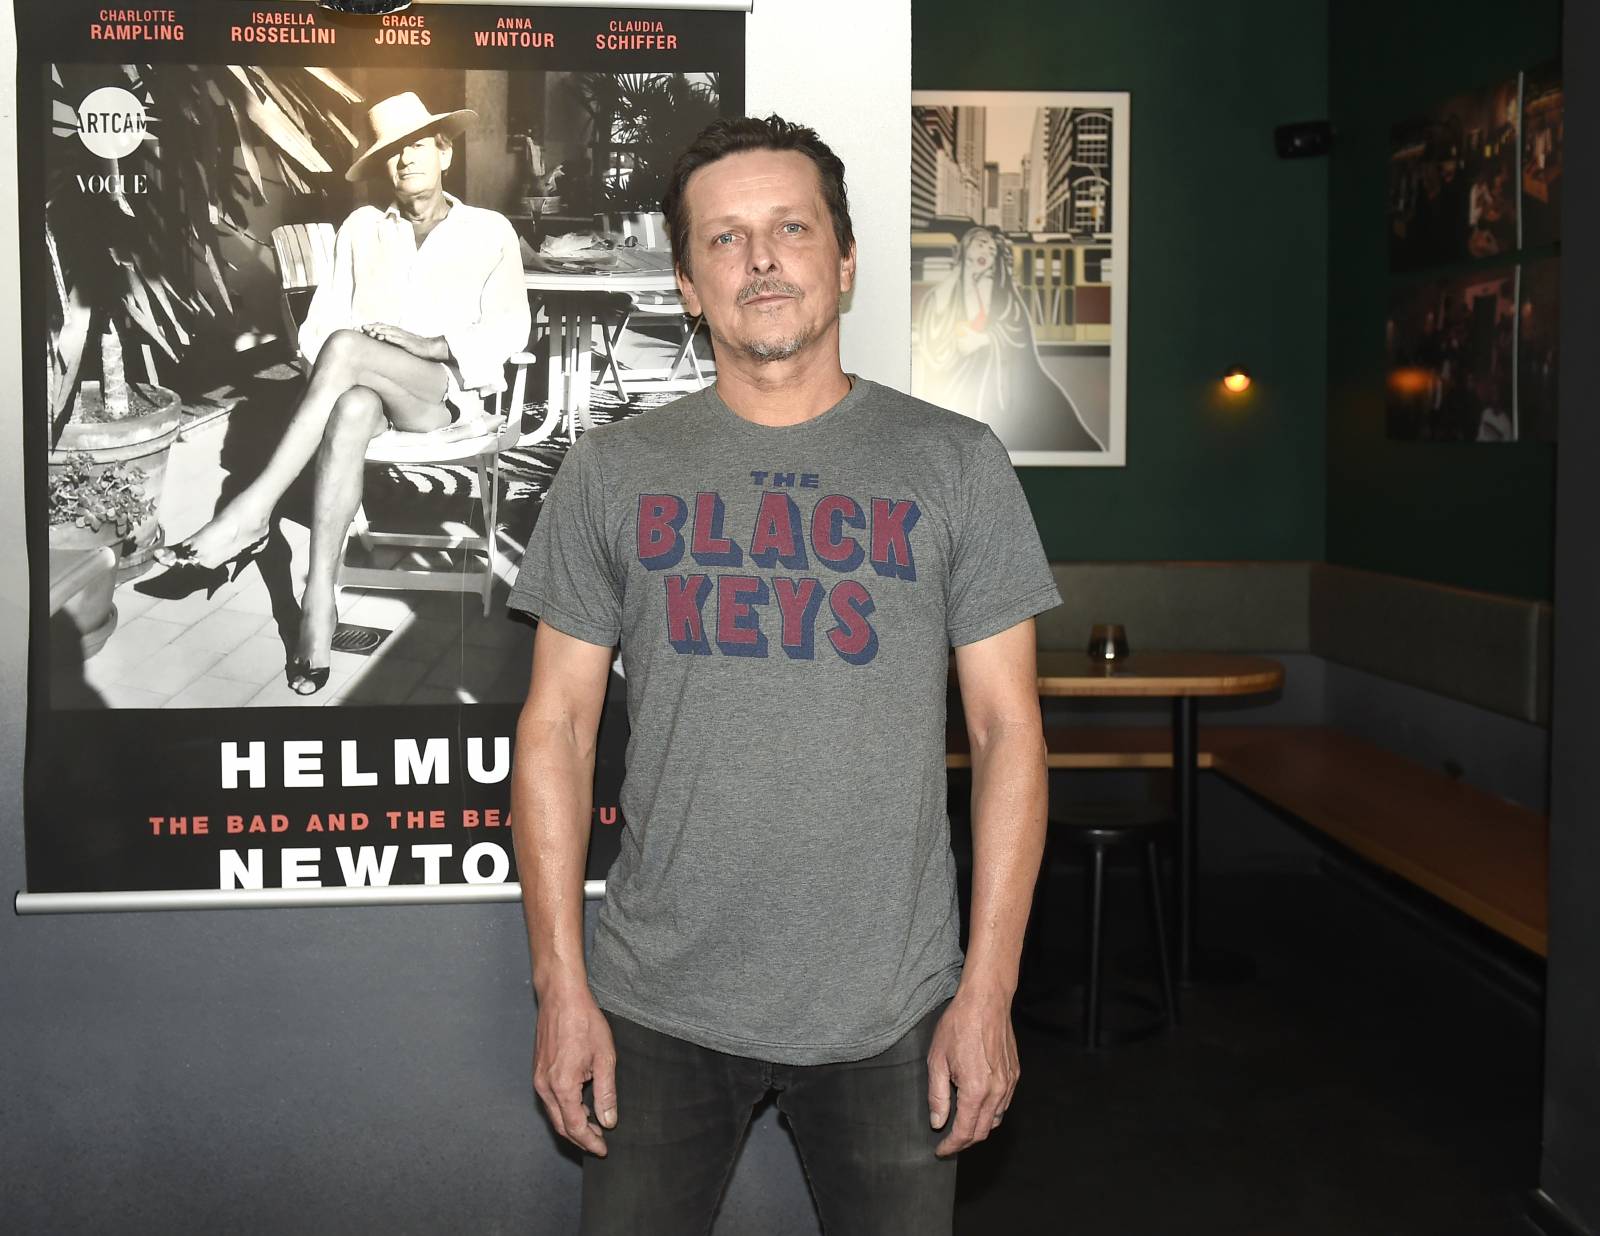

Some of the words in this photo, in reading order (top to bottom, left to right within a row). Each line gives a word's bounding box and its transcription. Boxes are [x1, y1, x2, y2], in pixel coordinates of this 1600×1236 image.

[99, 10, 176, 23] CHARLOTTE
[252, 12, 315, 25] ISABELLA
[382, 15, 425, 28] GRACE
[496, 18, 532, 30] ANNA
[90, 24, 184, 41] RAMPLING
[609, 21, 664, 33] CLAUDIA
[231, 27, 337, 45] ROSSELLINI
[374, 29, 432, 47] JONES
[474, 32, 555, 48] WINTOUR
[596, 35, 677, 50] SCHIFFER
[76, 174, 148, 193] VOGUE
[750, 471, 819, 488] THE
[637, 491, 921, 581] BLACK
[664, 574, 879, 665] KEYS
[221, 737, 510, 789] HELMU
[149, 815, 210, 836] THE
[227, 814, 289, 834] BAD
[306, 812, 370, 833] AND
[387, 810, 446, 830] THE
[219, 842, 510, 890] NEWTO
